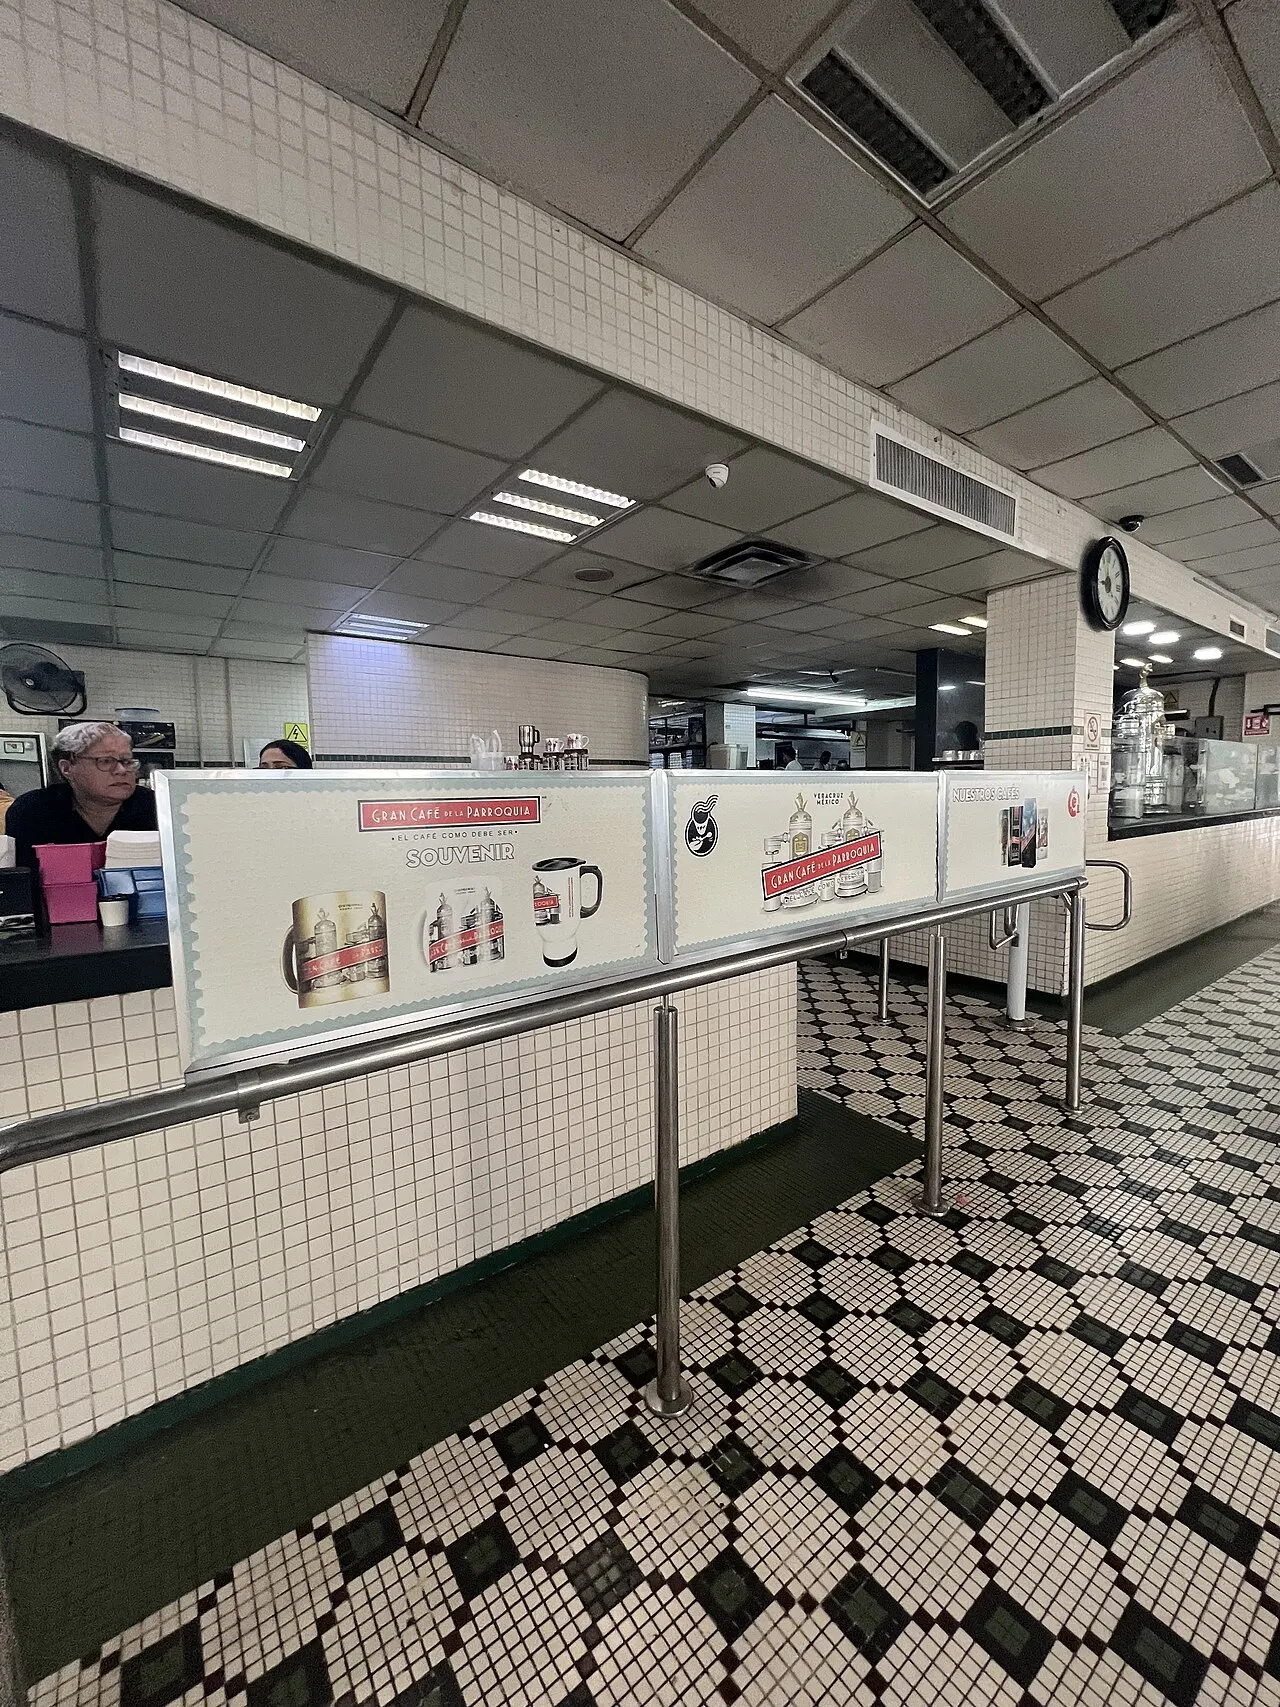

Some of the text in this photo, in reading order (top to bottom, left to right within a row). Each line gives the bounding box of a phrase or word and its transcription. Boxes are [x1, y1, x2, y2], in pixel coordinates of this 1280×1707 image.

[952, 787, 995, 802] NUESTROS
[371, 809, 406, 823] GRAN
[410, 806, 440, 822] CAFÉ
[467, 805, 531, 819] PARROQUIA
[397, 834, 409, 842] EL
[413, 832, 437, 841] CAFÉ
[441, 831, 467, 839] COMO
[471, 830, 493, 838] DEBE
[405, 843, 514, 869] SOUVENIR
[771, 871, 794, 889] GRAN
[796, 861, 816, 880] CAFÉ
[832, 843, 875, 867] PARROQUIA
